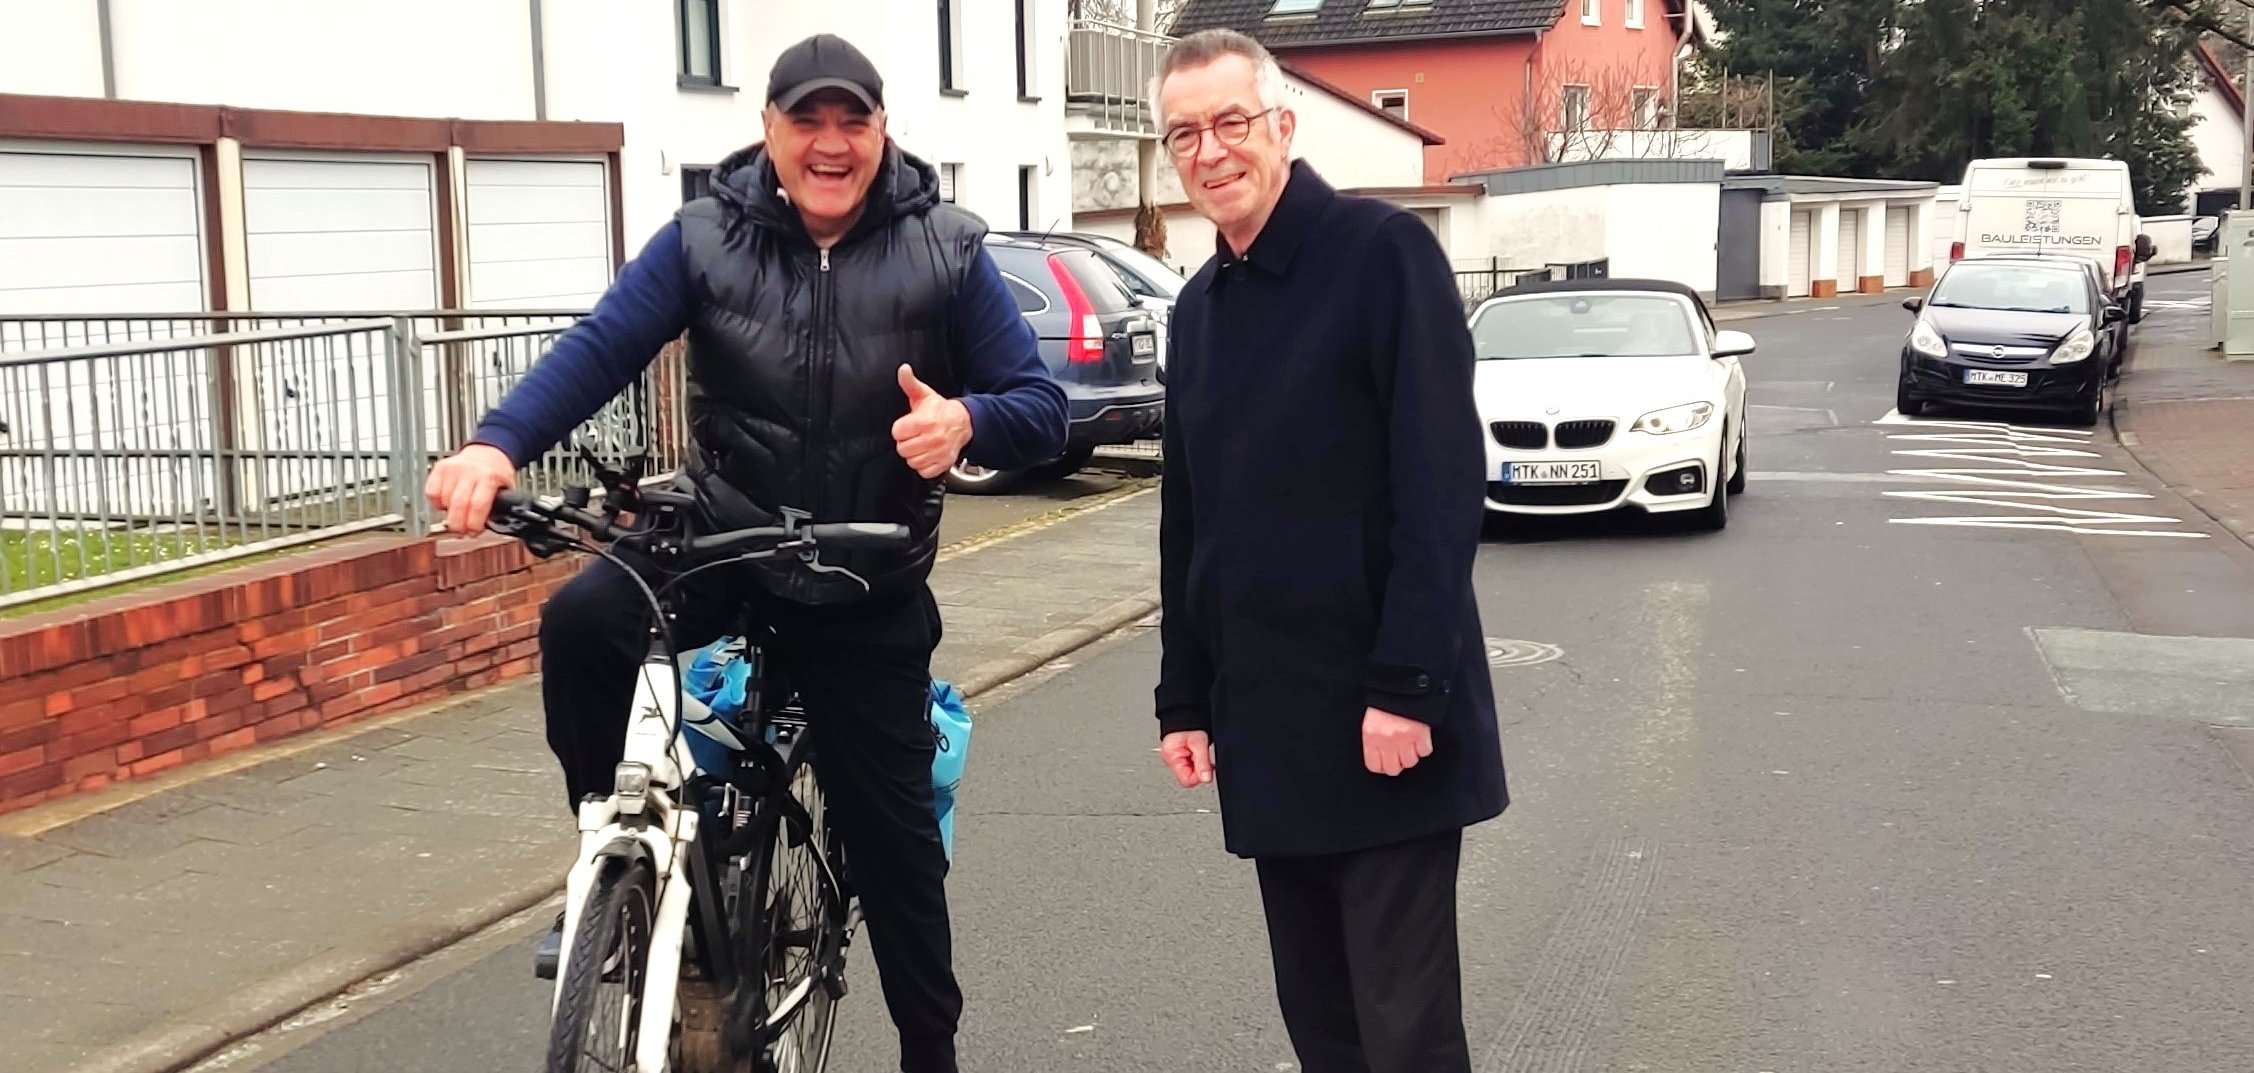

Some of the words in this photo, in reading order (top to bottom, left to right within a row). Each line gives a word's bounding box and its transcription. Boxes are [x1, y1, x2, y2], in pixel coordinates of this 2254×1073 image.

[1981, 234, 2102, 245] BAULEISTUNGEN
[1513, 464, 1538, 479] MTK
[1550, 464, 1568, 479] NN
[1571, 463, 1598, 479] 251
